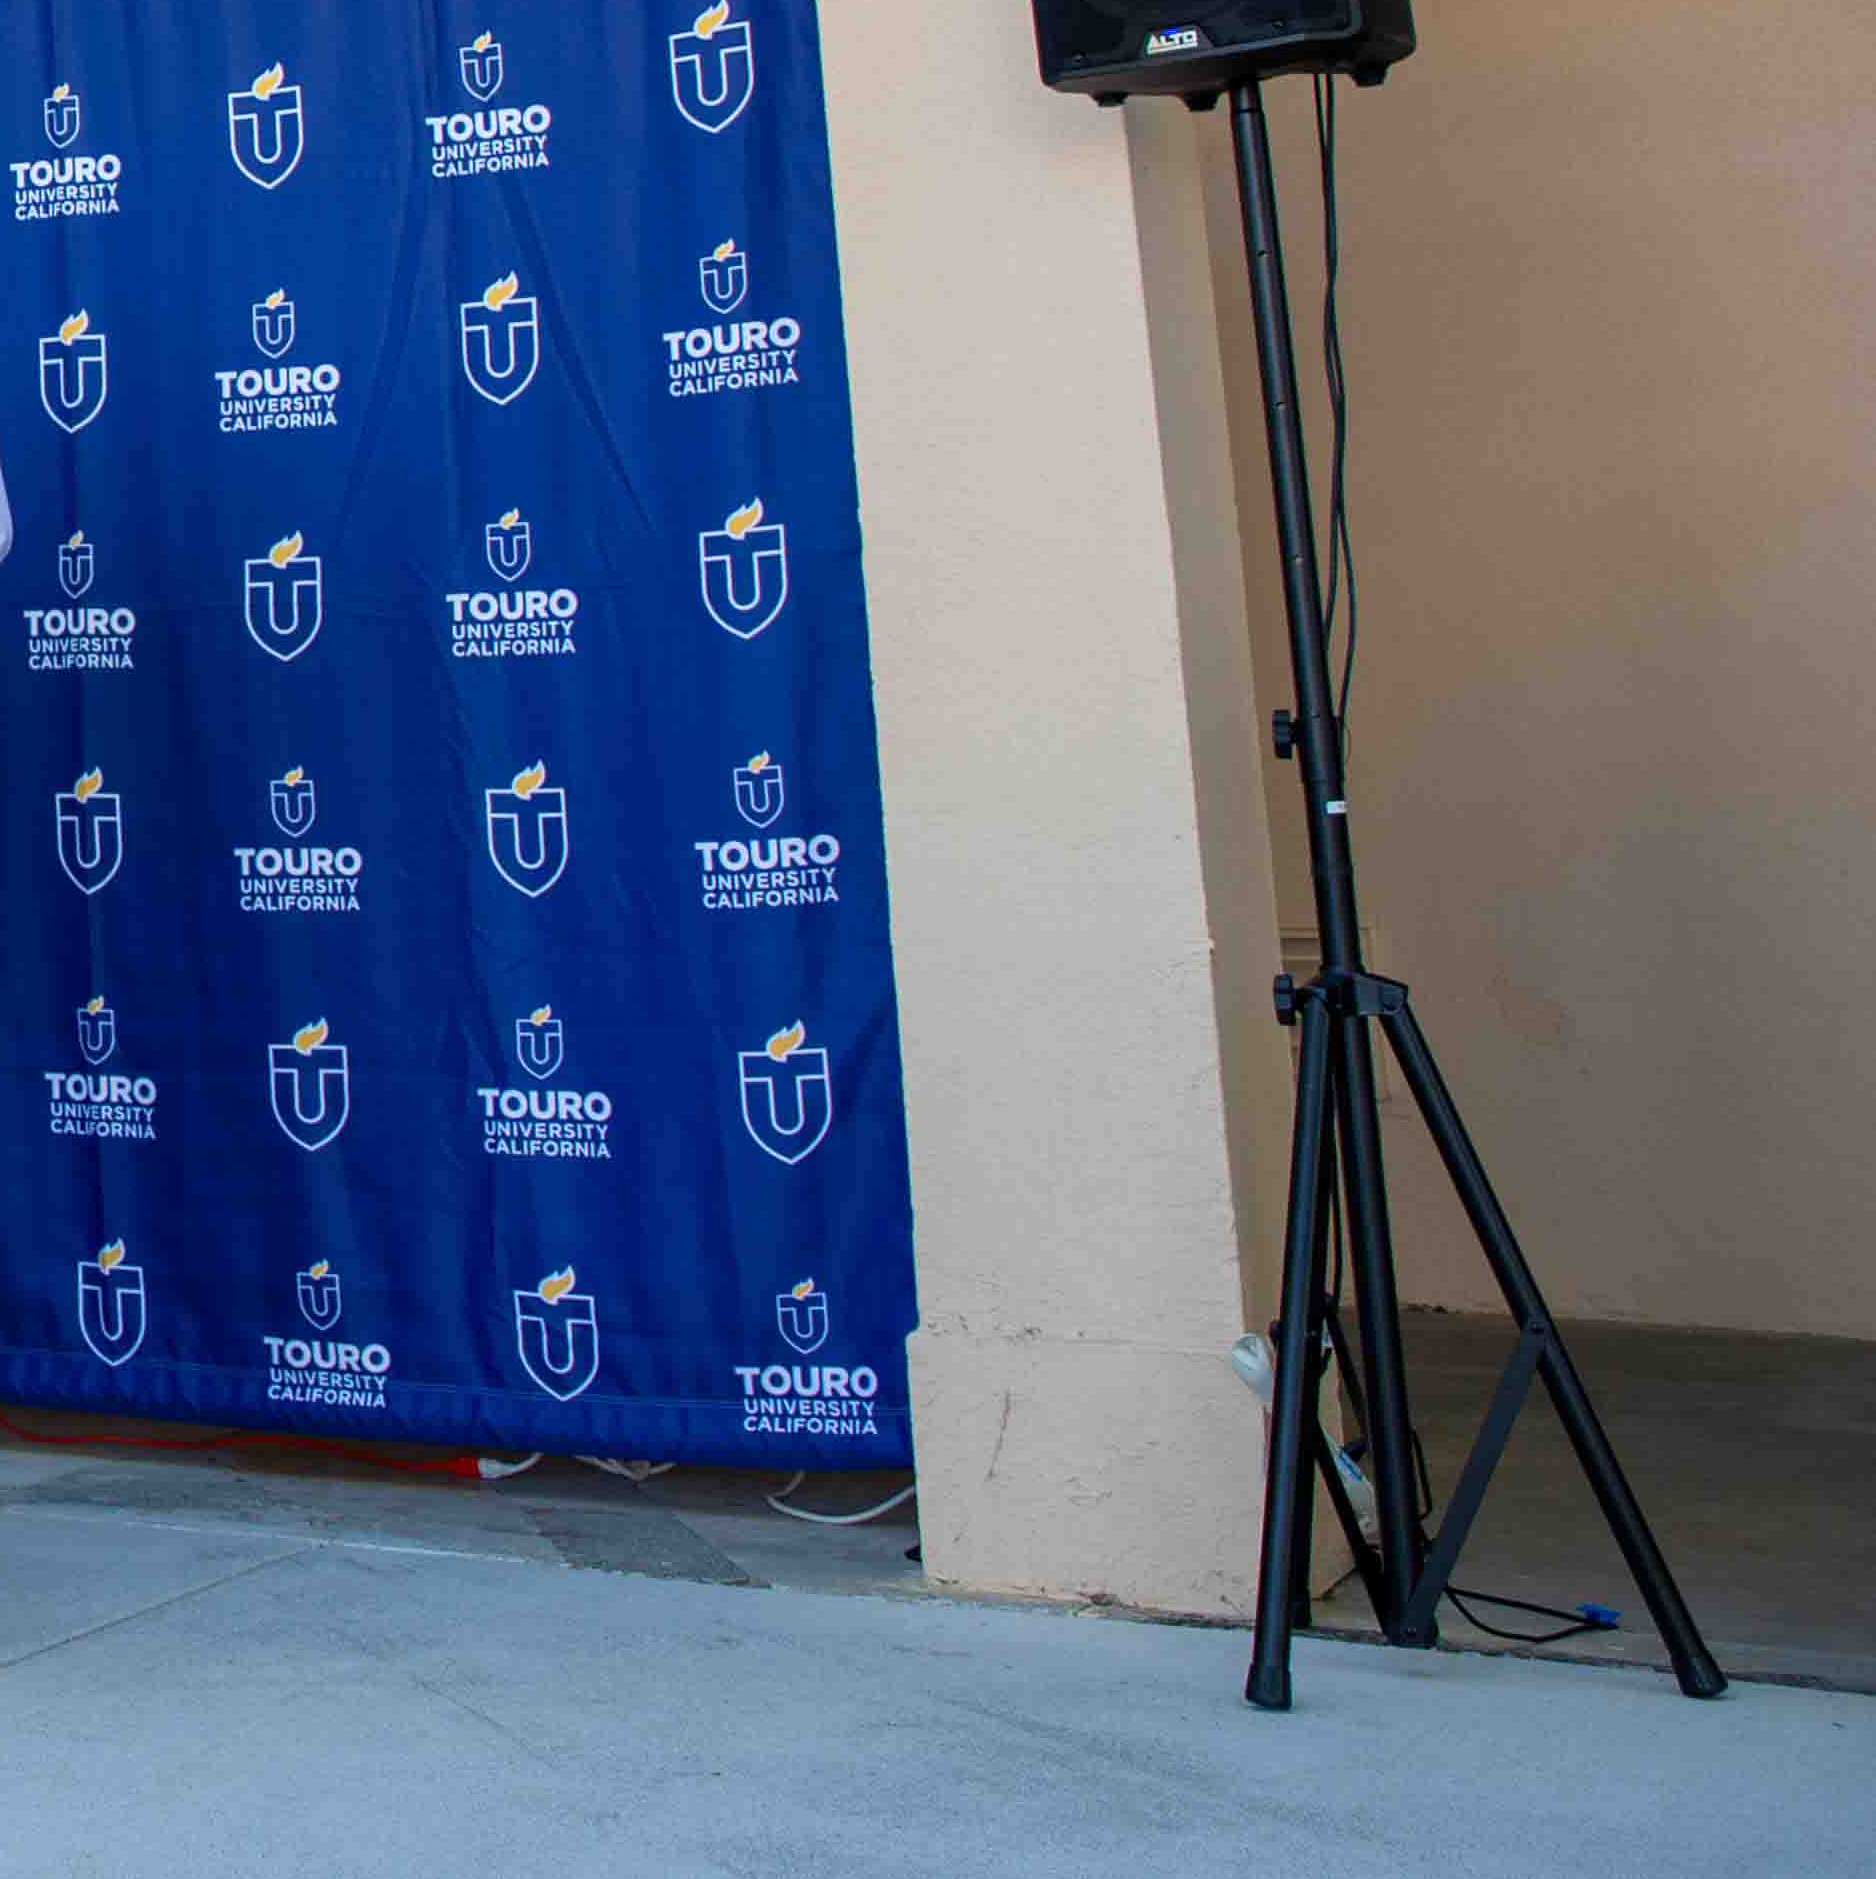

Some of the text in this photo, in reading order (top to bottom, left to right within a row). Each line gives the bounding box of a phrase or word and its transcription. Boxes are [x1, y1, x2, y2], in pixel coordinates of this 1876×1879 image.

[1147, 29, 1198, 53] ALTO
[426, 105, 551, 144] TOURO
[432, 135, 547, 161] UNIVERSITY
[10, 154, 120, 188] TOURO
[433, 152, 549, 177] CALIFORNIA
[16, 183, 117, 204] UNIVERSITY
[16, 199, 119, 220] CALIFORNIA
[663, 318, 800, 361] TOURO
[670, 349, 796, 378] UNIVERSITY
[215, 364, 340, 398] TOURO
[670, 368, 798, 396] CALIFORNIA
[221, 394, 335, 415] UNIVERSITY
[220, 411, 336, 431] CALIFORNIA
[446, 589, 578, 621] TOURO
[24, 608, 136, 636] TOURO
[453, 620, 573, 639] UNIVERSITY
[30, 638, 131, 653] UNIVERSITY
[453, 638, 575, 656] CALIFORNIA
[29, 654, 133, 669] CALIFORNIA
[235, 848, 362, 876] TOURO
[695, 835, 840, 871] TOURO
[241, 878, 358, 893] UNIVERSITY
[704, 868, 835, 890] UNIVERSITY
[241, 896, 360, 911] CALIFORNIA
[704, 886, 839, 908] CALIFORNIA
[45, 1074, 156, 1105] TOURO
[51, 1103, 152, 1122] UNIVERSITY
[478, 1089, 611, 1121] TOURO
[51, 1119, 155, 1138] CALIFORNIA
[485, 1122, 608, 1139] UNIVERSITY
[485, 1138, 610, 1158] CALIFORNIA
[264, 1337, 390, 1373] TOURO
[271, 1368, 386, 1390] UNIVERSITY
[736, 1366, 877, 1397] TOURO
[268, 1385, 385, 1407] CALIFORNIA
[744, 1400, 874, 1417] UNIVERSITY
[744, 1416, 877, 1434] CALIFORNIA
